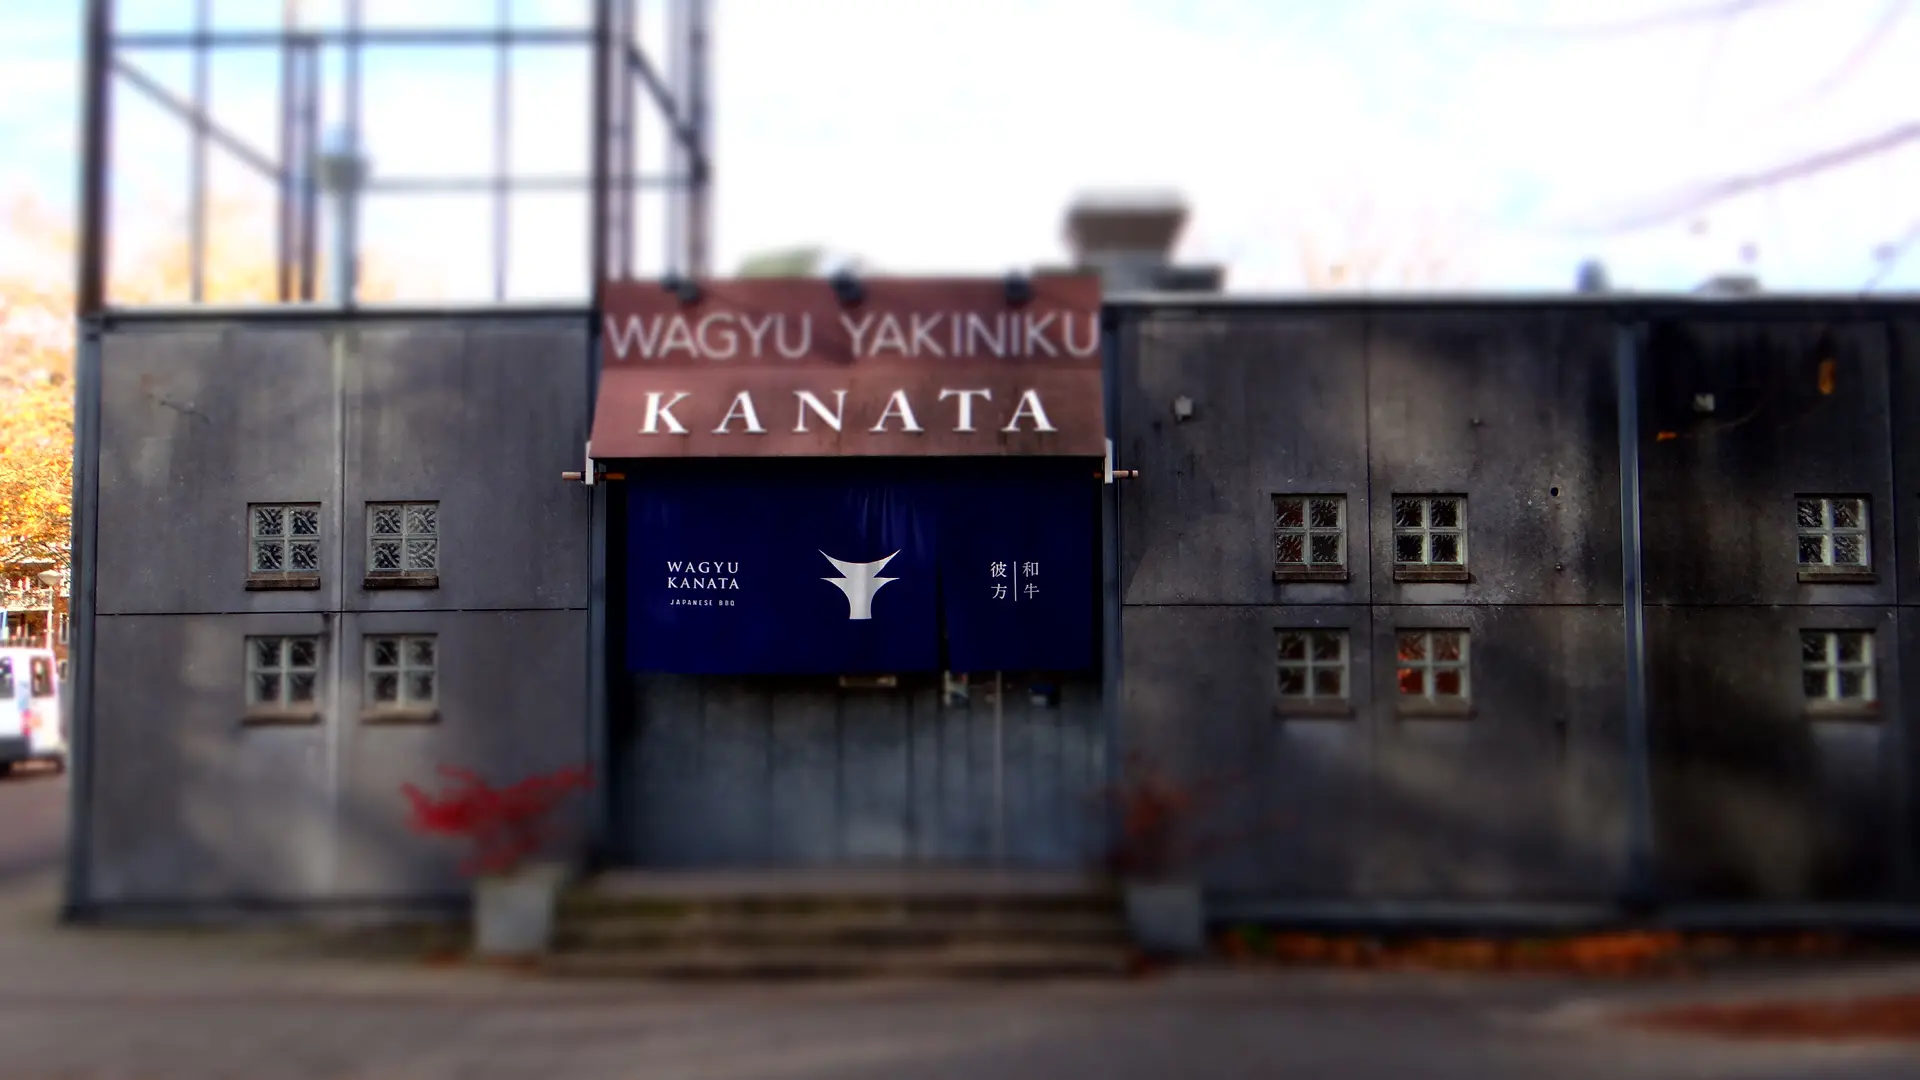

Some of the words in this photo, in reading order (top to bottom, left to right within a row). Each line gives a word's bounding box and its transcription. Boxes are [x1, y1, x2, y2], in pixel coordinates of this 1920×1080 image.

[607, 312, 812, 358] WAGYU
[840, 312, 1100, 358] YAKINIKU
[639, 389, 1058, 434] KANATA
[667, 561, 739, 574] WAGYU
[667, 577, 740, 589] KANATA
[990, 561, 1007, 600] 彼方
[1022, 561, 1040, 600] 和牛
